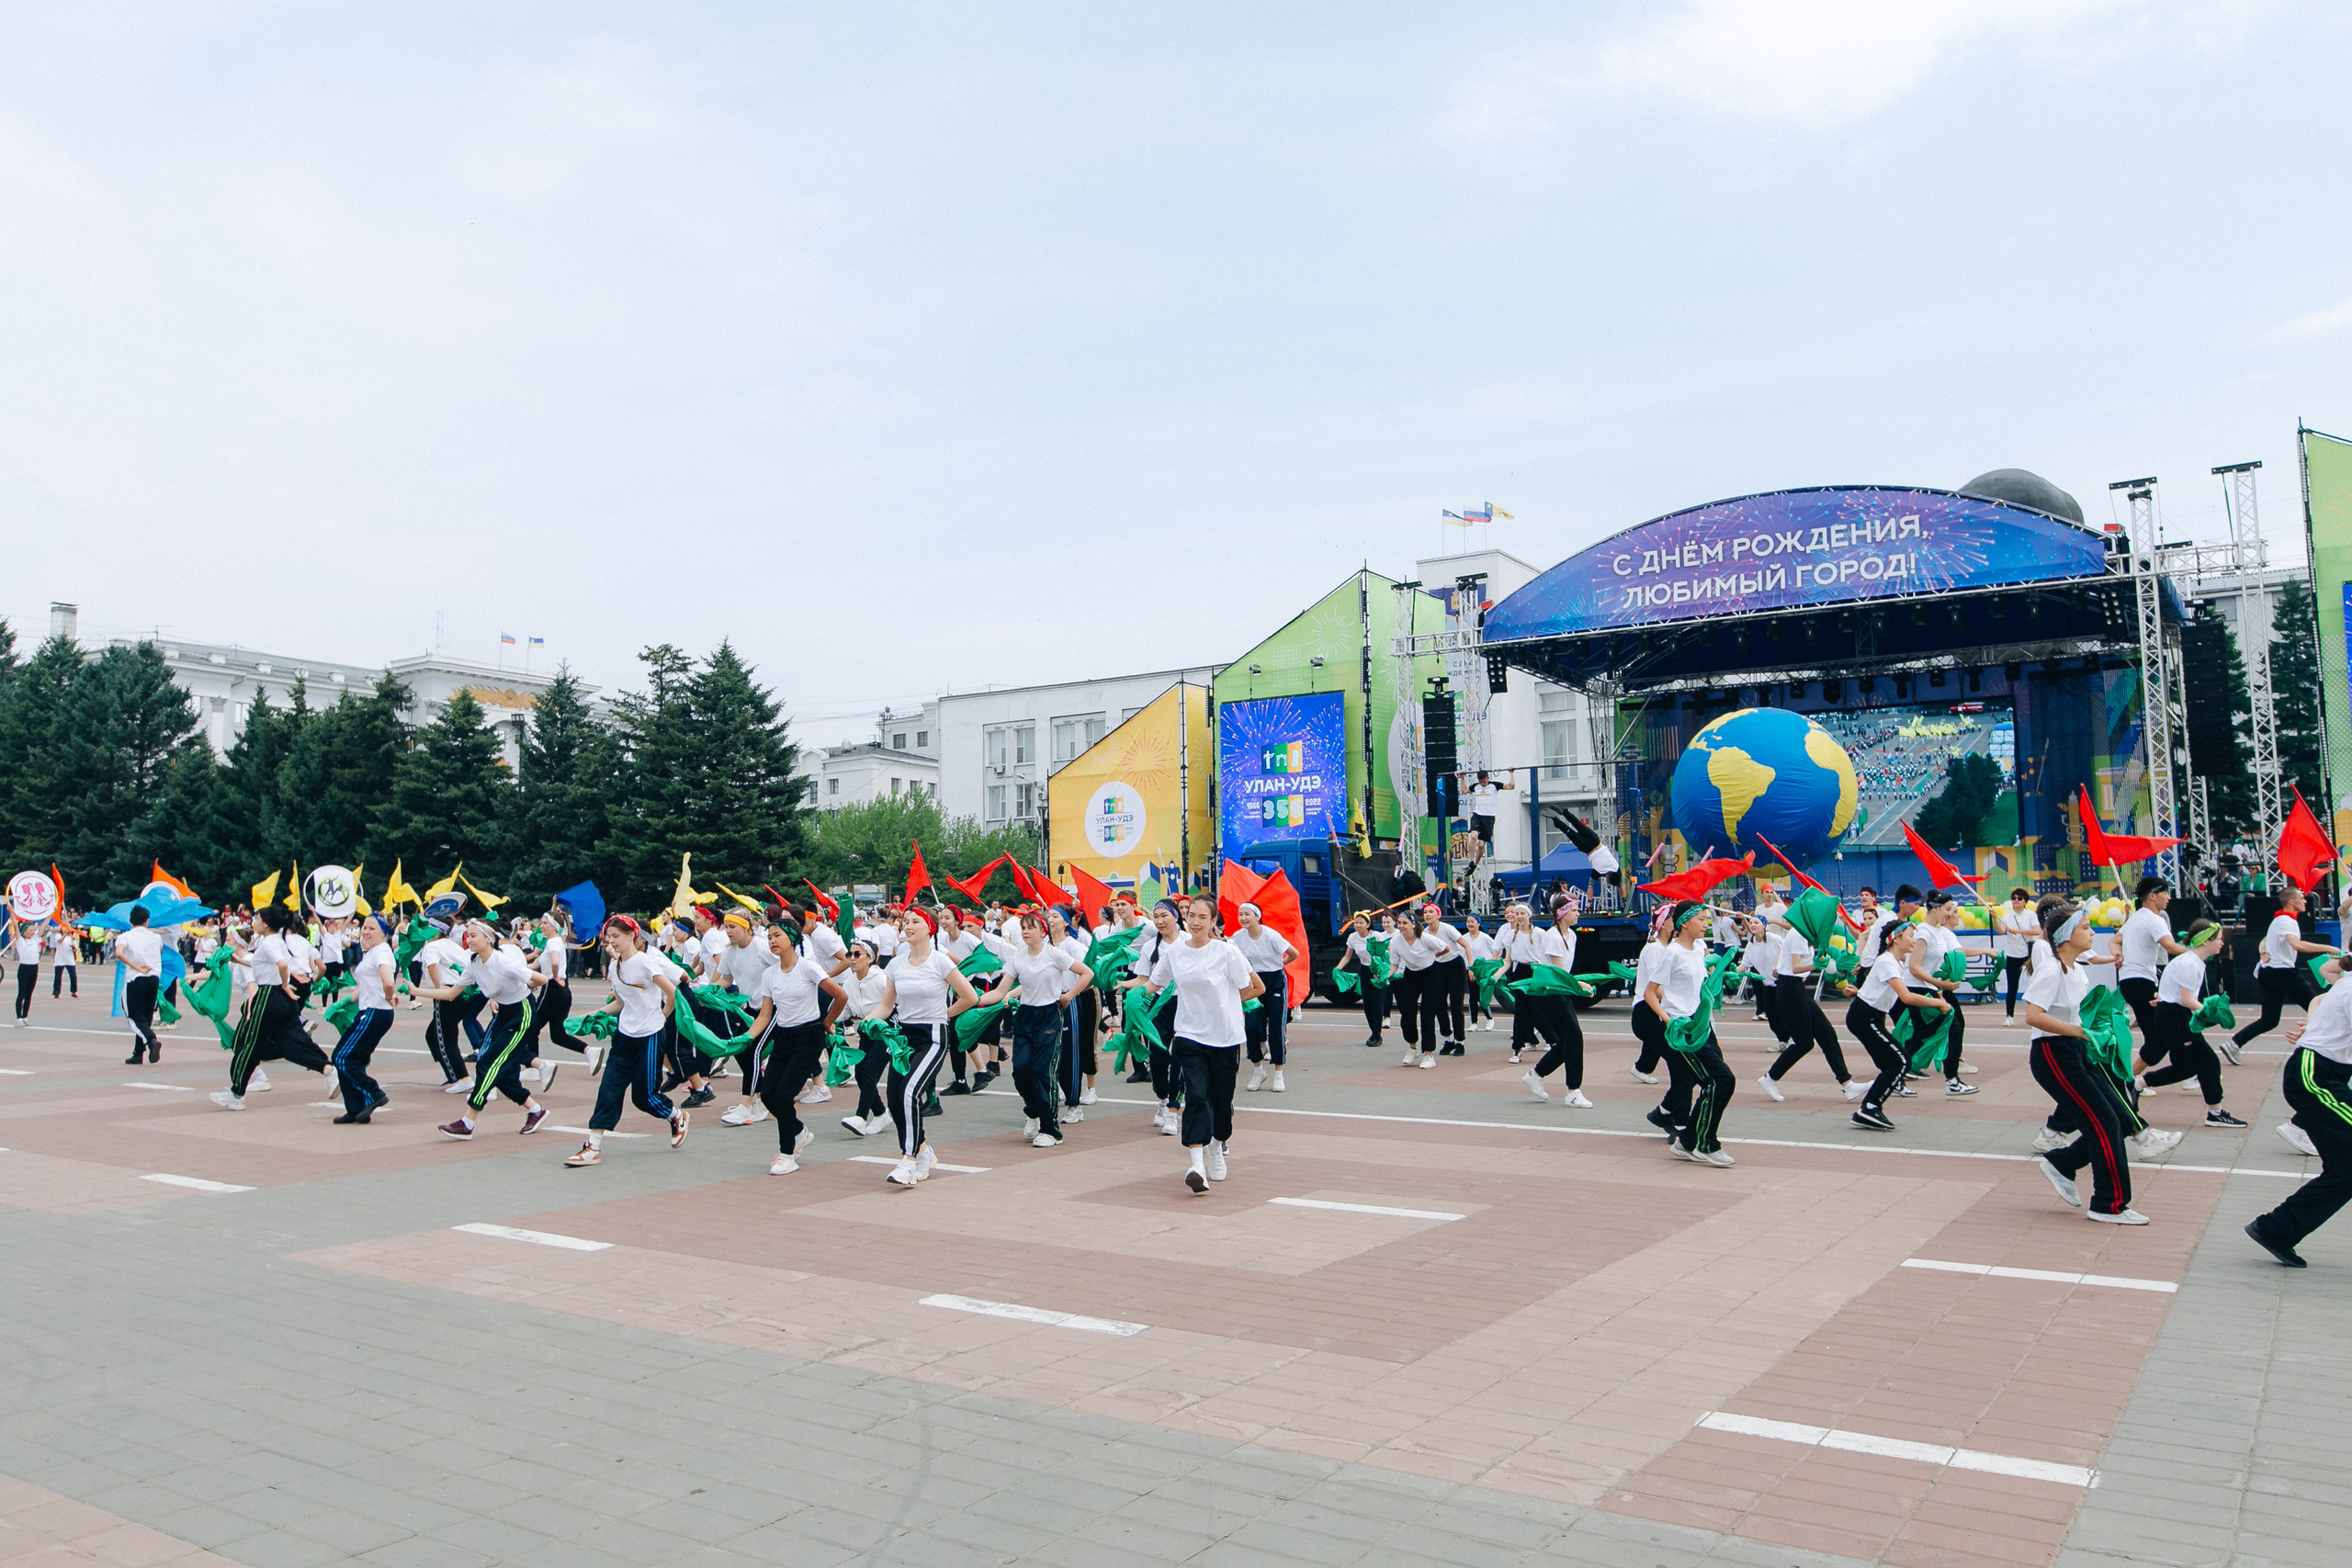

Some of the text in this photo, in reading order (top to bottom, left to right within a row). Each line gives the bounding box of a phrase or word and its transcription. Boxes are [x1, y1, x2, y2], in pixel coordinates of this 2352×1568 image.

[1612, 514, 1928, 576] С ДНЁМ РОЖДЕНИЯ,
[1623, 553, 1916, 609] ЛЮБИМЫЙ ГОРОД!
[1244, 775, 1321, 794] УЛАН-УДЭ
[1262, 798, 1304, 819] 356
[1305, 797, 1321, 806] 2022
[1096, 815, 1134, 824] УЛАН-УДЭ
